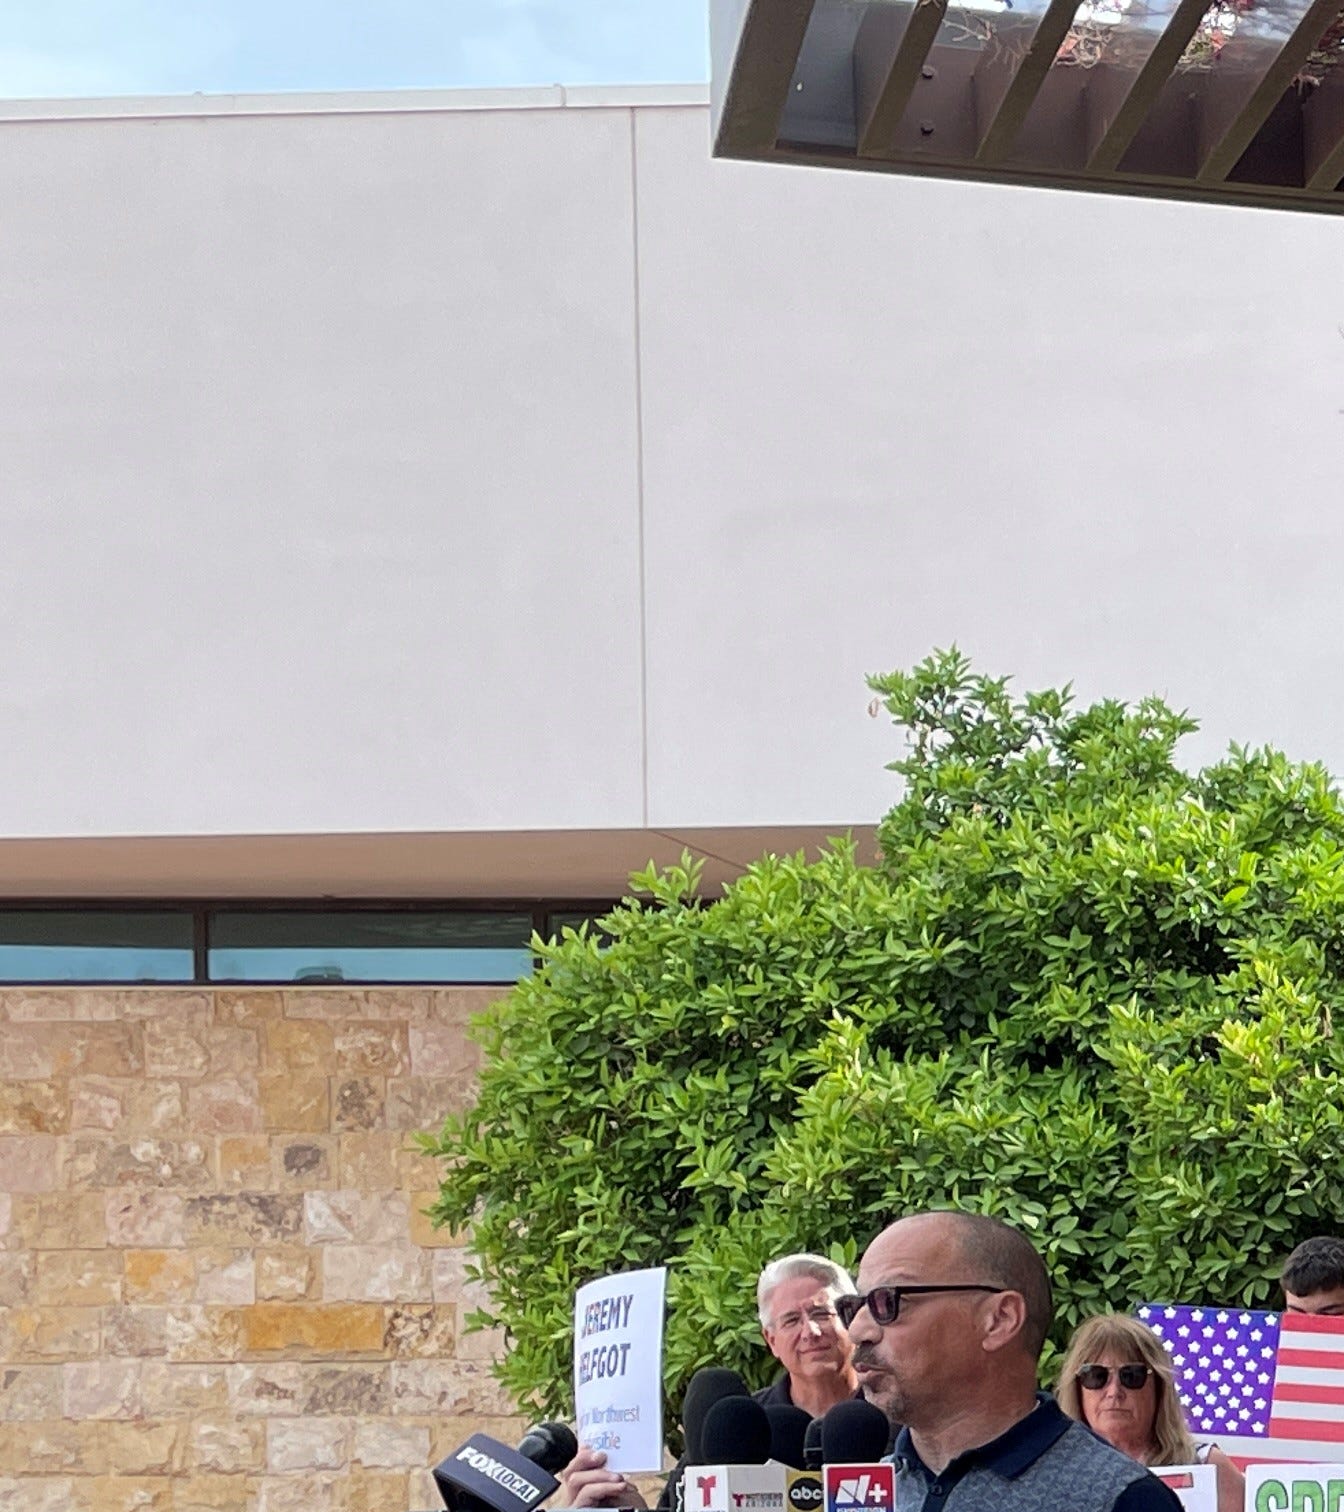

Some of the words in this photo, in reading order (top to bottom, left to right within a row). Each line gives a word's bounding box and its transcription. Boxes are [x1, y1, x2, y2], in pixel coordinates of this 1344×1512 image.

[456, 1446, 502, 1476] FOX
[493, 1464, 540, 1503] LOCAL
[790, 1486, 823, 1500] abc
